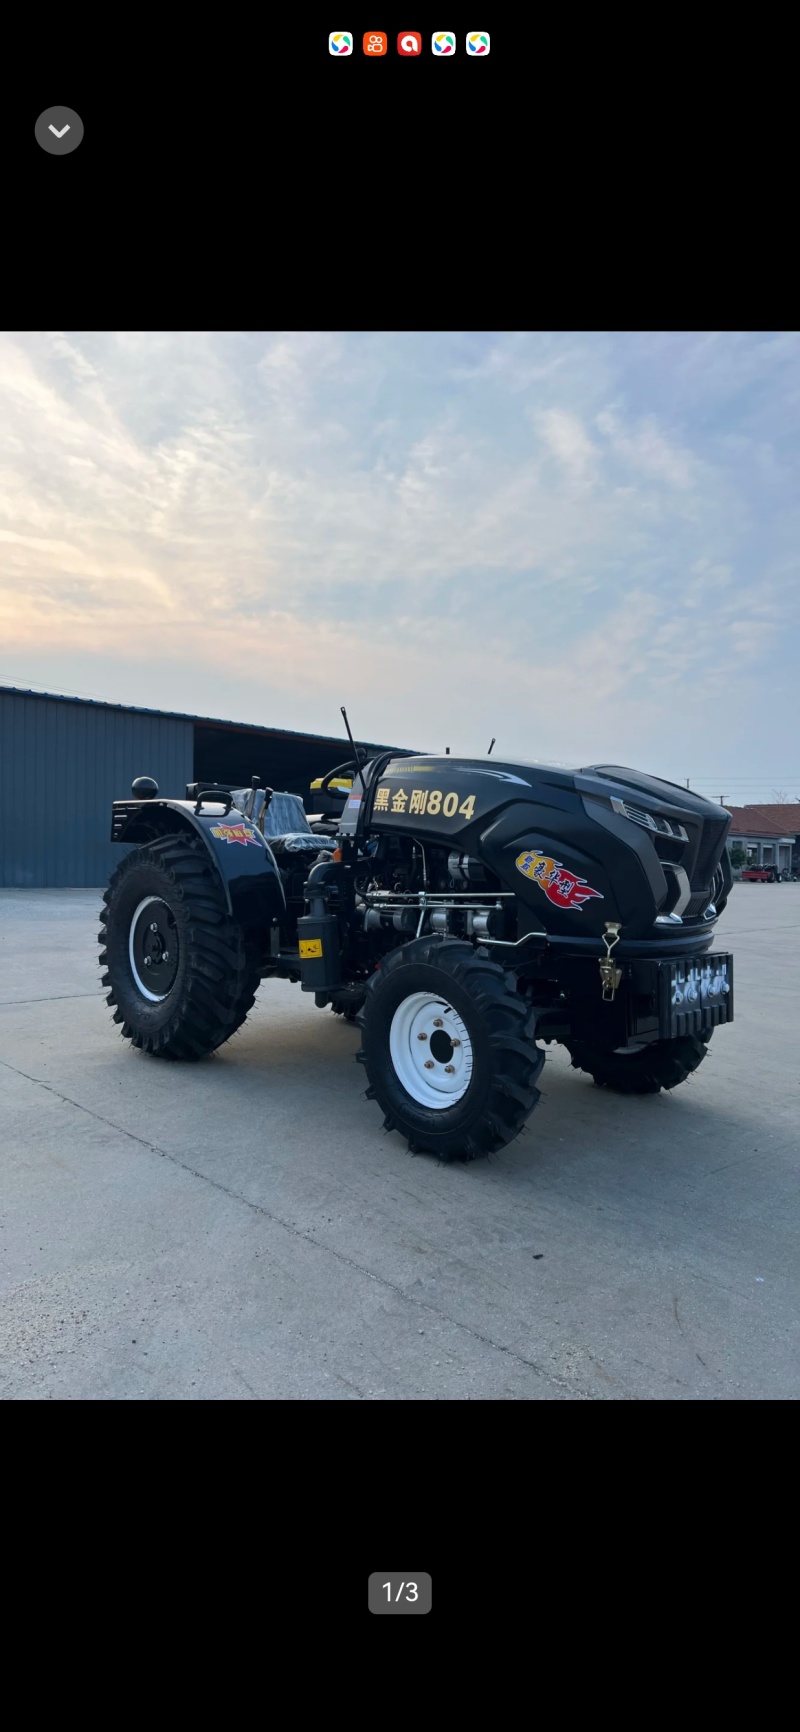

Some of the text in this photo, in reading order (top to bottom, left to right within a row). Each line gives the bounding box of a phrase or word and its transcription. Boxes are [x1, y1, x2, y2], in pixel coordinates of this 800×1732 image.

[373, 787, 477, 820] 黑金刚804
[533, 861, 575, 898] 豪华型
